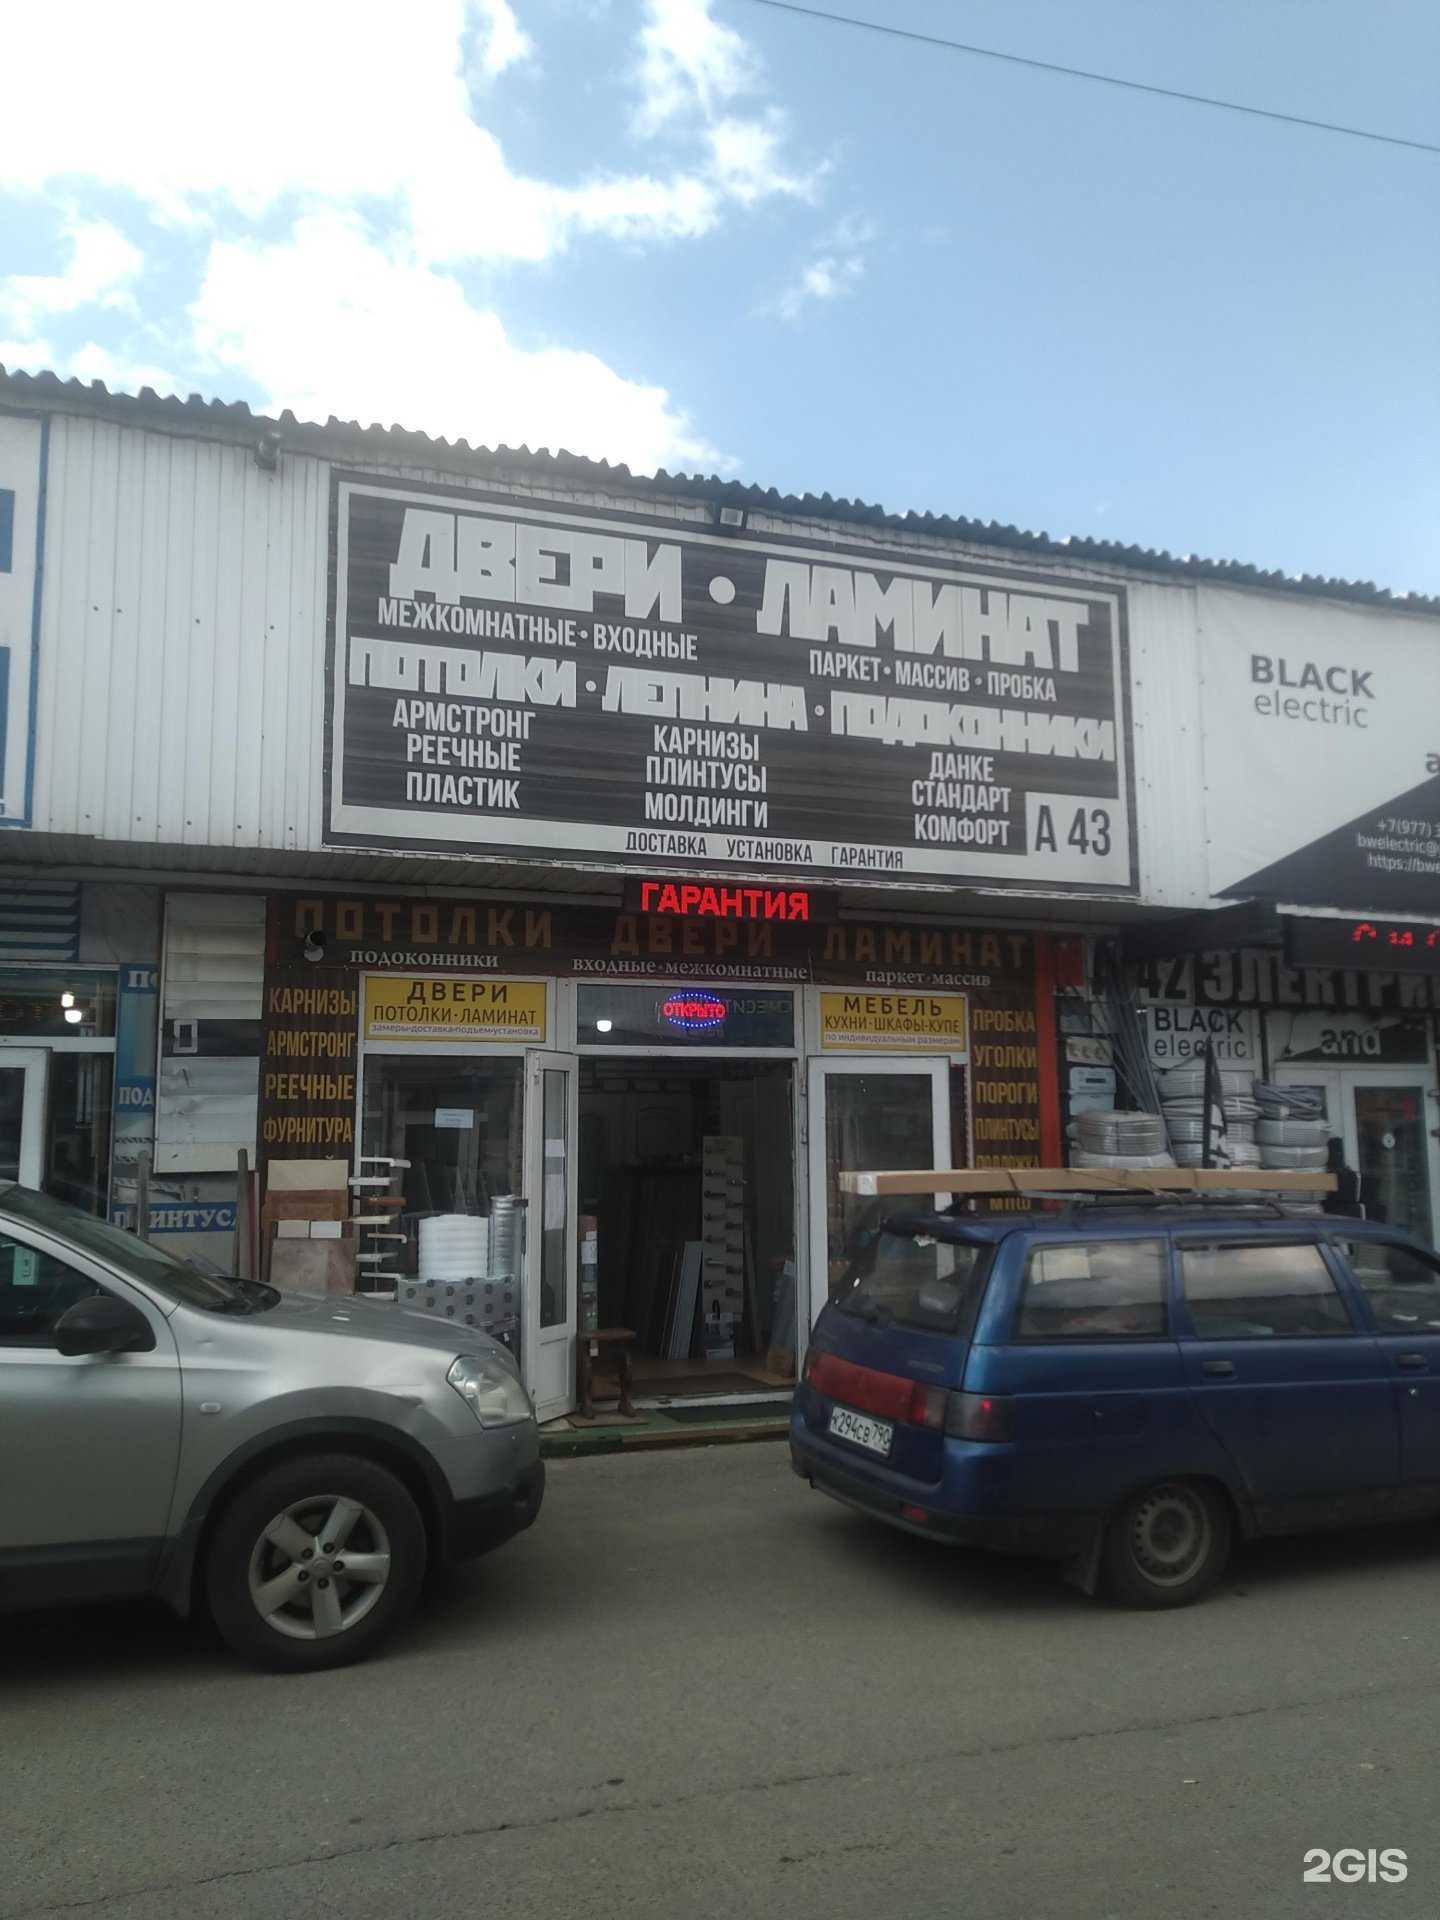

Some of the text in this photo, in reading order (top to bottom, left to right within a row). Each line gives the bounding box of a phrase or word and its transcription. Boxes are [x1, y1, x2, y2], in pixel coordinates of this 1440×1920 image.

[389, 508, 1090, 672] ДВЕРИ ЛАМИНАТ
[378, 598, 698, 661] МЕЖКОМНАТНЫЕ ВХОДНЫЕ
[810, 649, 1057, 701] ПАРКЕТ МАССИВ ПРОБКА
[1251, 654, 1375, 699] BLACK
[349, 637, 1115, 761] ПОТОЛКИ ЛЕПНИНА ПОДОКОННИКИ
[1254, 689, 1368, 728] electric
[393, 699, 535, 739] АРМСТРОНГ
[407, 734, 521, 772] РЕЕЧНЫЕ
[654, 725, 759, 760] КАРНИЗЫ
[646, 756, 767, 793] ПЛИНТУСЫ
[929, 752, 994, 782] ДАНКЕ
[406, 772, 520, 809] ПЛАСТИК
[912, 780, 1011, 813] СТАНДАРТ
[645, 792, 768, 829] МОЛДИНГИ
[915, 814, 1010, 846] КОМФОРТ
[1068, 808, 1111, 856] 43
[626, 831, 903, 869] ДОСТАВКА УСТАНОВКА ГАРАНТИЯ
[641, 882, 808, 921] ГАРАНТИЯ
[295, 899, 551, 948] ПОТОЛКИ
[609, 915, 773, 958] ДВЕРИ
[824, 925, 1026, 968] ЛАМИНАТ
[665, 961, 808, 980] межкомнатные
[865, 969, 992, 986] паркет массив
[1202, 947, 1440, 1009] ЭЛЕКТРИ
[268, 987, 356, 1016] КАРНИЗЫ
[407, 981, 508, 1004] ДВЕРИ
[844, 996, 942, 1016] МЕБЕЛЬ
[374, 1005, 537, 1025] ПОТОЛКИ ЛАМИНАТ
[663, 1001, 728, 1019] ОТКРЫТО
[825, 1016, 867, 1030] КУХНИ
[973, 1009, 1036, 1032] ПРОБКА
[1155, 1007, 1243, 1033] BLACK
[266, 1031, 355, 1057] АРМСТРОНГ
[974, 1045, 1038, 1068] УГОЛКИ
[1154, 1035, 1247, 1058] electric
[1320, 1028, 1382, 1056] and
[264, 1074, 354, 1100] РЕЕЧНЫЕ
[976, 1081, 1038, 1104] ПОРОГИ
[263, 1116, 352, 1144] ФУРНИТУРА
[975, 1118, 1039, 1141] ПЛИНТУСЫ
[113, 1206, 238, 1230] ПИНТУС
